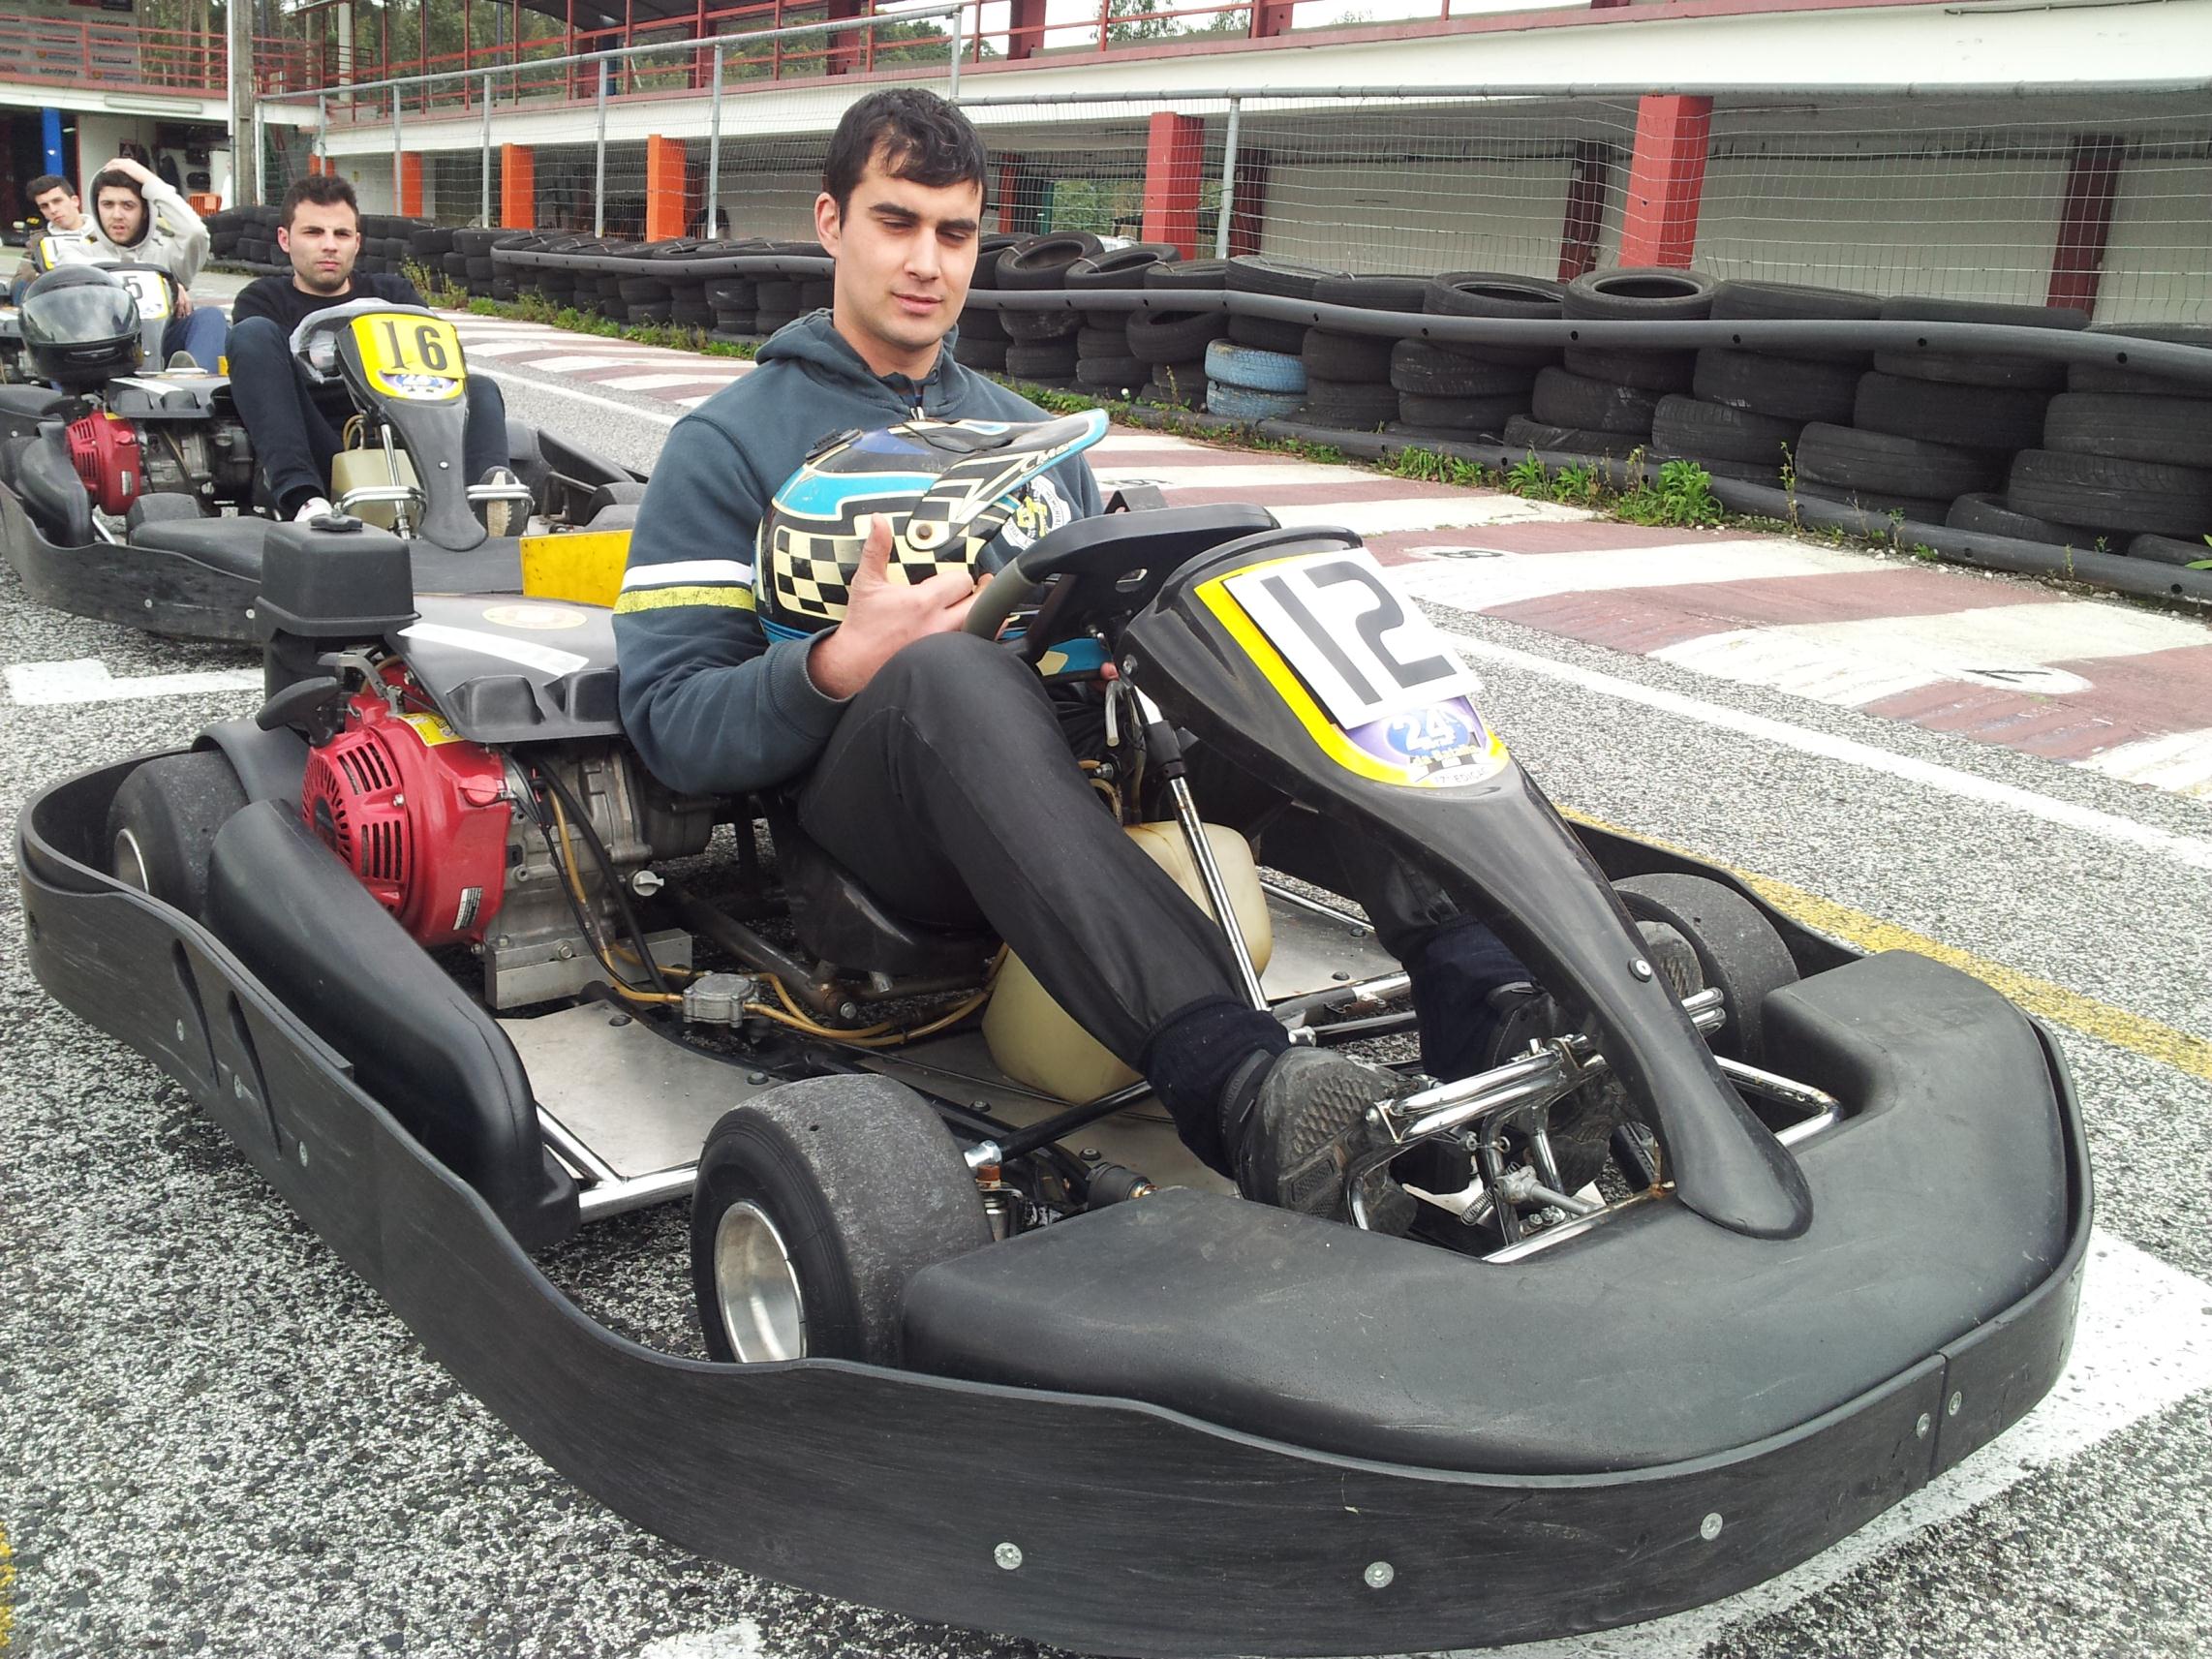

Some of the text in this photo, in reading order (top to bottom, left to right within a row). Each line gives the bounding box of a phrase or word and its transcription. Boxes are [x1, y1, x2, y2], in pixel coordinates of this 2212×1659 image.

[122, 276, 143, 300] 5
[381, 321, 448, 372] 16
[1259, 560, 1458, 706] 12
